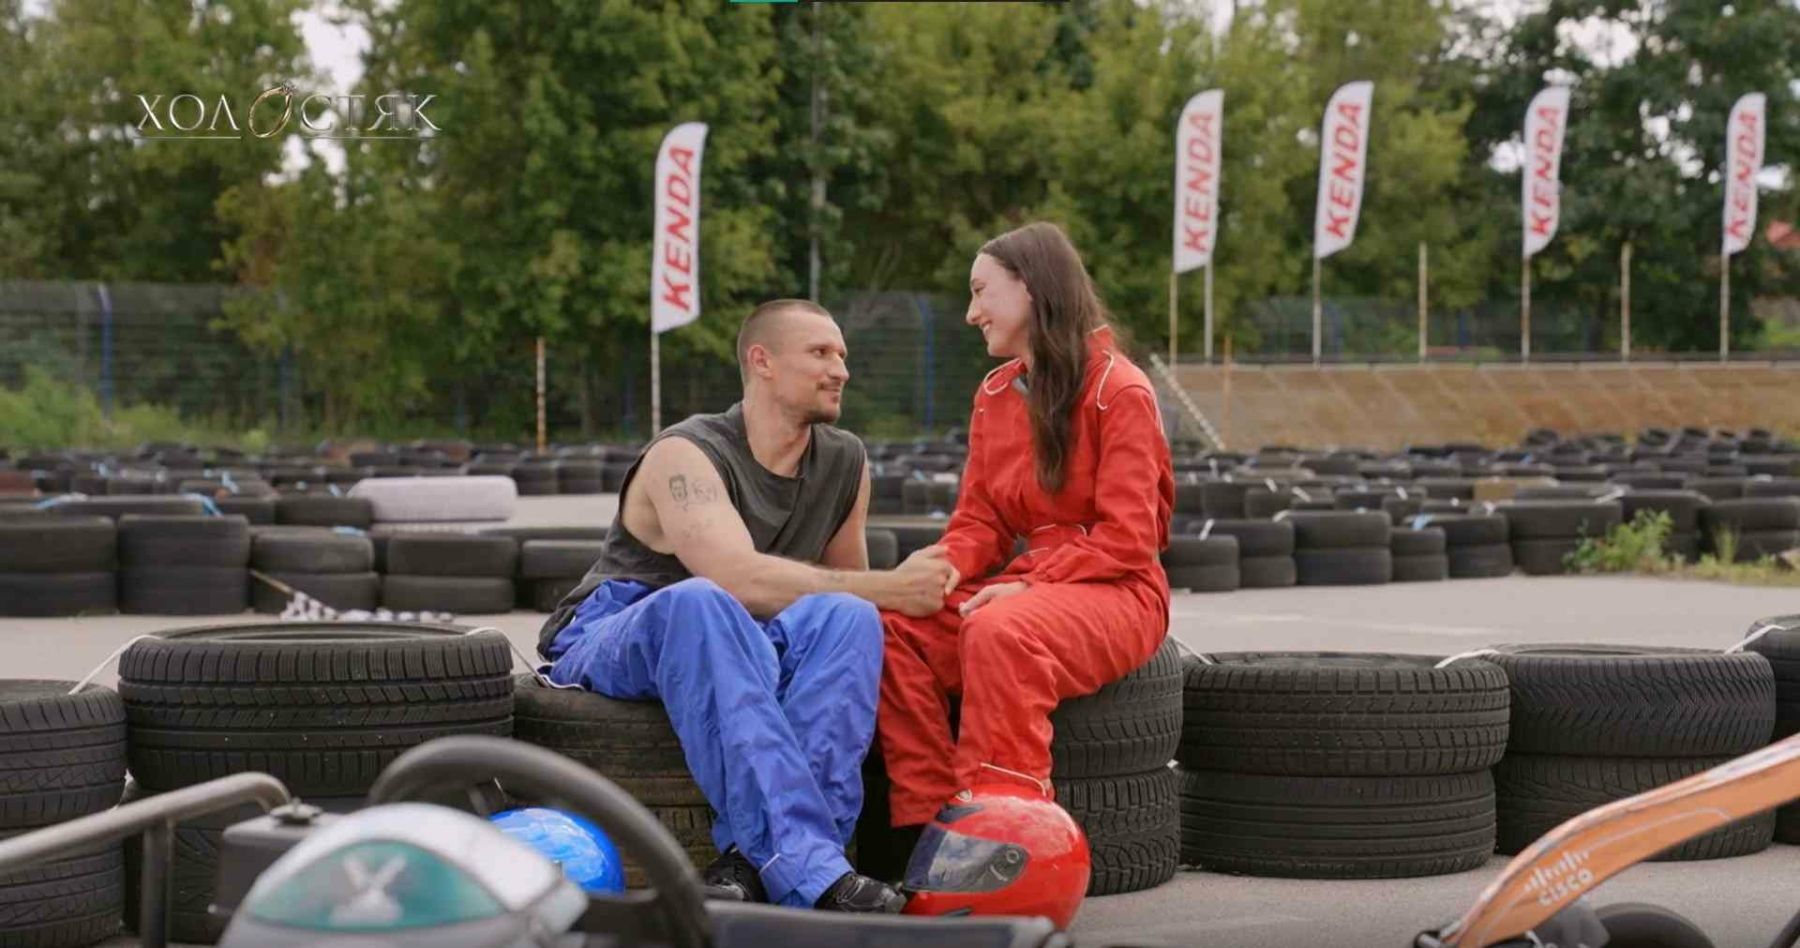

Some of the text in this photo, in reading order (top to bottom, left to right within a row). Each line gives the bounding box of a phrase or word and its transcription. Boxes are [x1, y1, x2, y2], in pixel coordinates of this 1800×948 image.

[662, 146, 695, 313] KENDA
[1183, 111, 1214, 254] KENDA
[1322, 101, 1362, 240] KENDA
[1529, 106, 1561, 237] KENDA
[1725, 110, 1758, 240] KENDA
